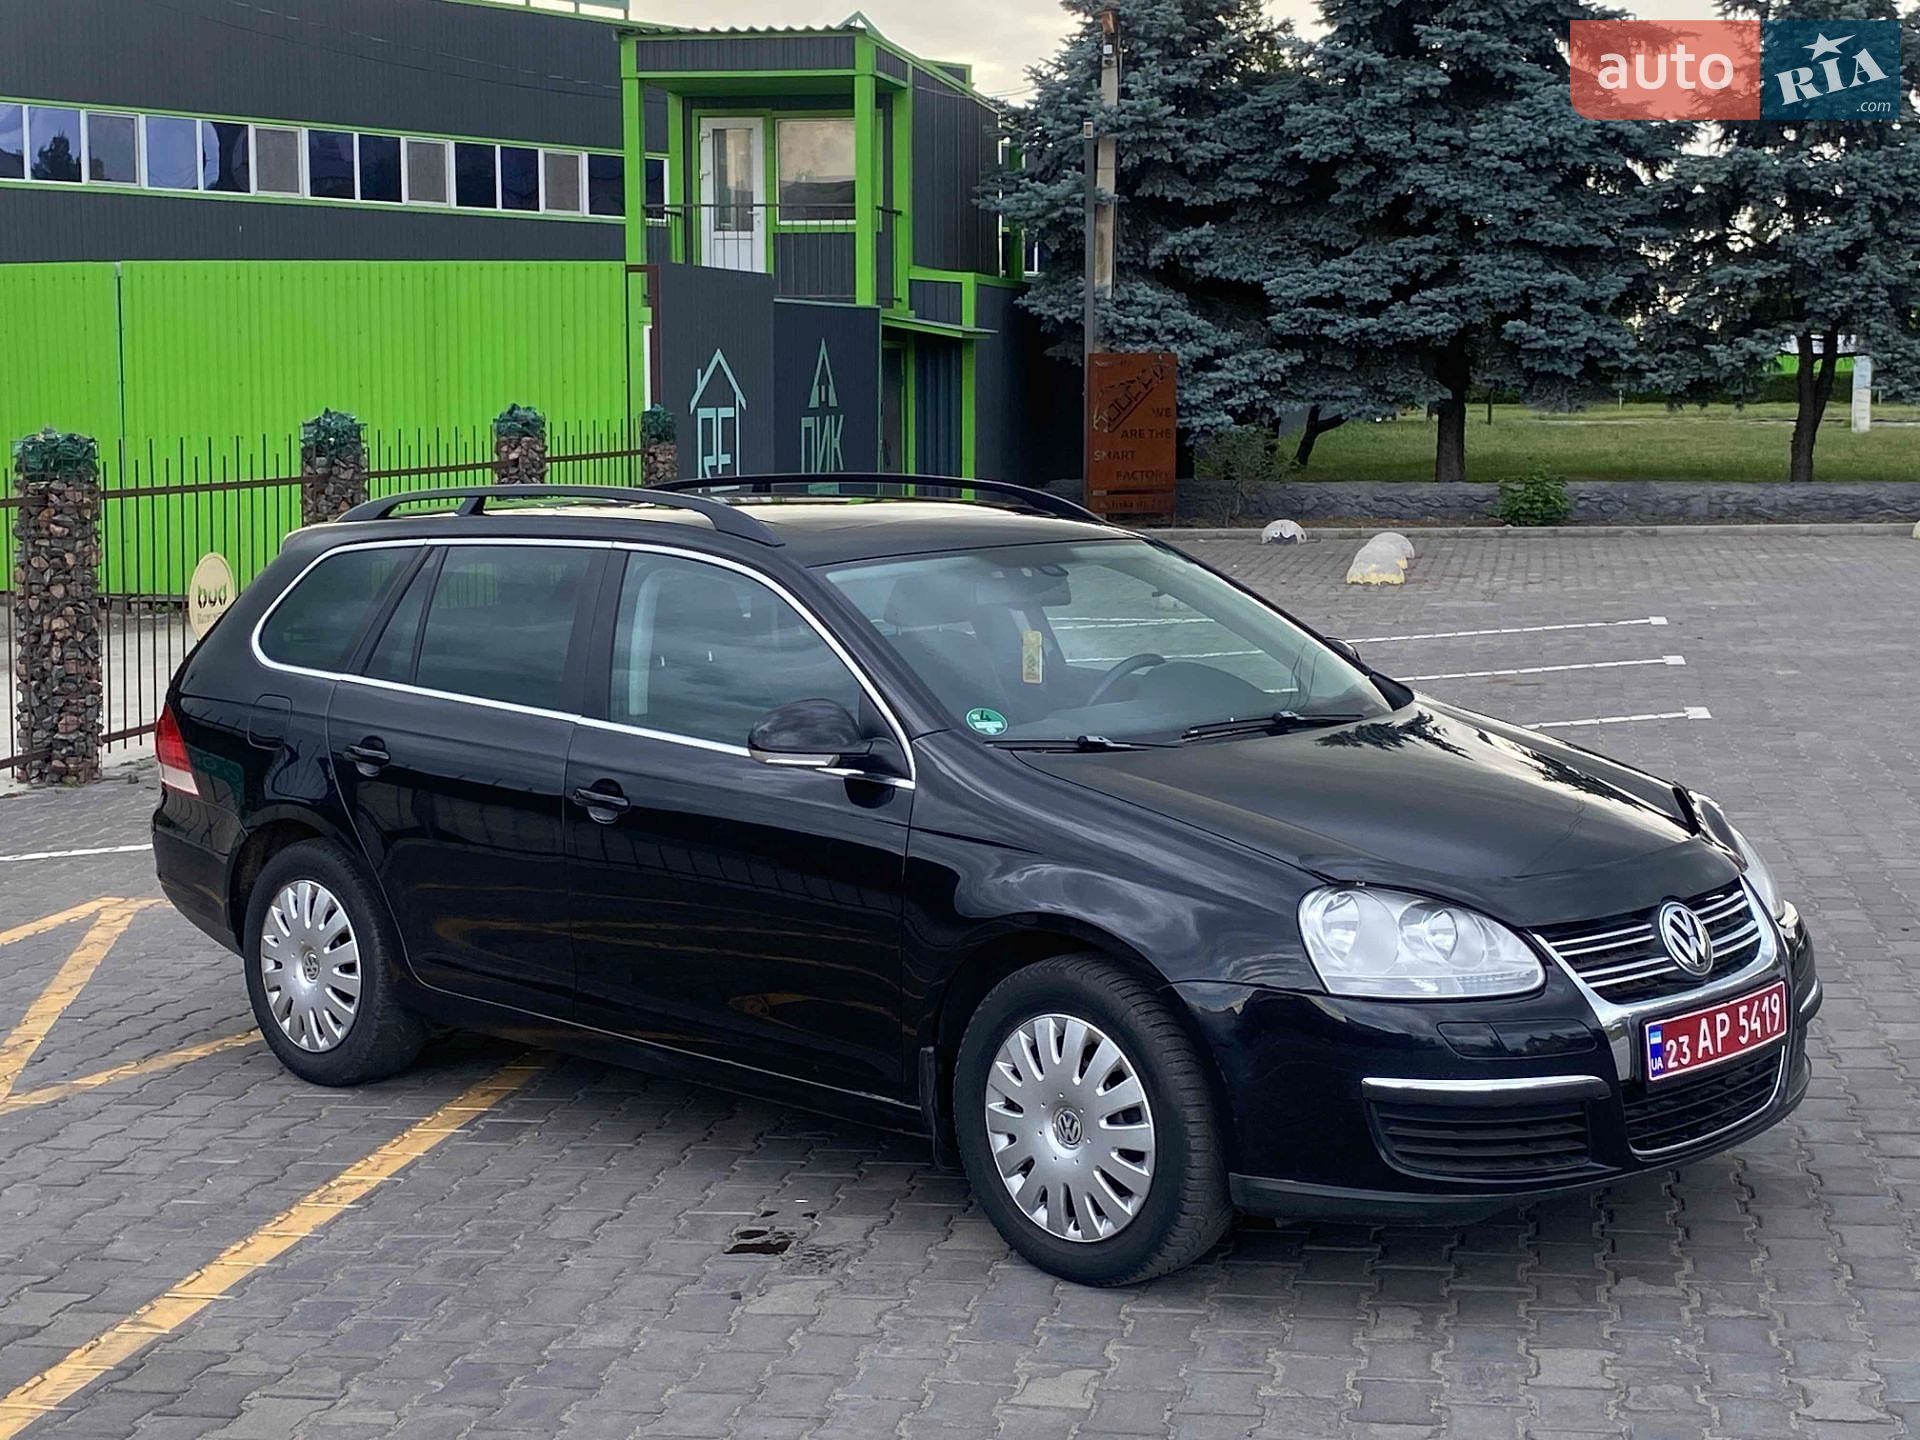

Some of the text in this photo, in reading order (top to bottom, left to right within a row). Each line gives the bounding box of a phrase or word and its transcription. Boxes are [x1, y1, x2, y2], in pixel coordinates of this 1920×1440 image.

[1152, 407, 1172, 418] WE
[1120, 428, 1172, 440] ARE THE
[1093, 450, 1137, 461] SMART
[1665, 906, 1709, 970] VW
[1665, 992, 1780, 1069] 23 AP 5419
[1651, 1056, 1664, 1071] UA
